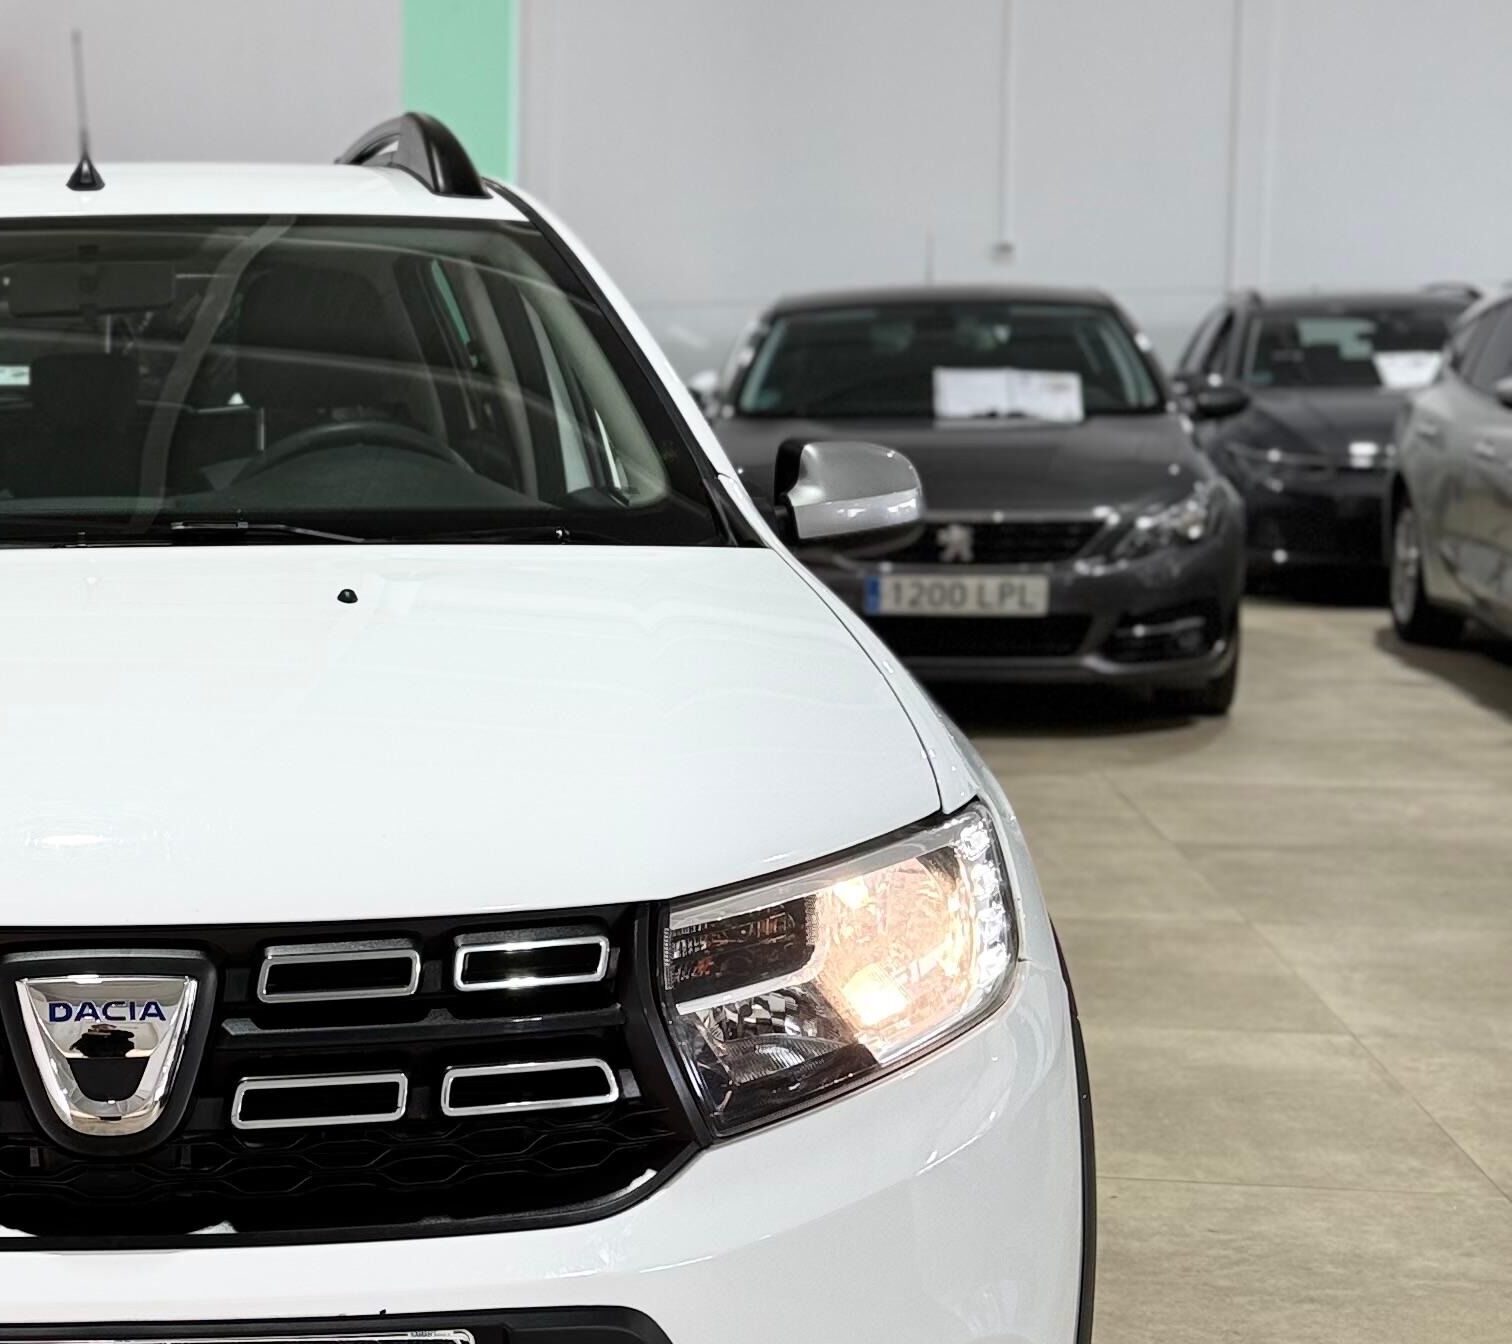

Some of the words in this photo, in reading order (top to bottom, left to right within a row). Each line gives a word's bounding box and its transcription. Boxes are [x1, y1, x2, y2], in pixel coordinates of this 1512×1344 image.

[892, 581, 968, 609] 1200
[977, 581, 1034, 609] LPL
[48, 1001, 167, 1022] DACIA
